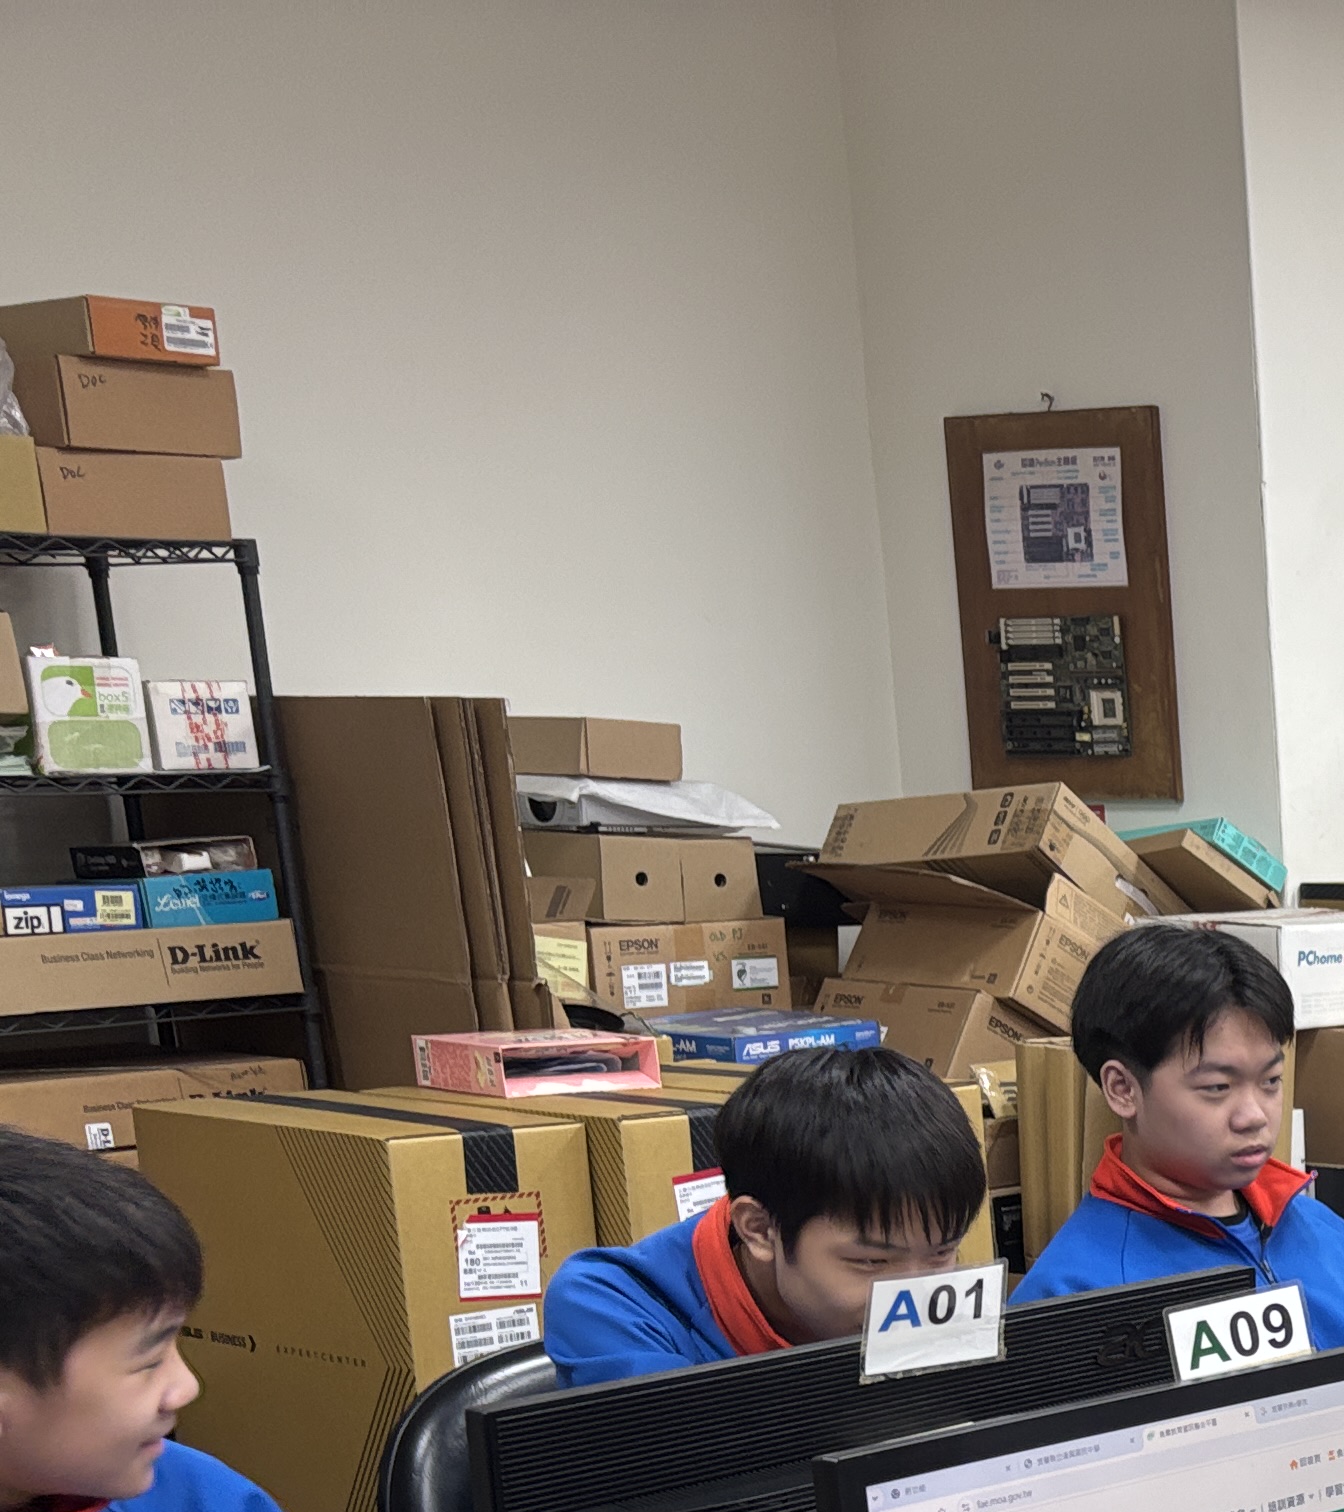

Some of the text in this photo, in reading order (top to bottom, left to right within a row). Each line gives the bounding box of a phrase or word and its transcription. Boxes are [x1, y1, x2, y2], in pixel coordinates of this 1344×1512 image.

[13, 910, 42, 934] zip
[105, 947, 155, 961] Networking
[167, 940, 262, 966] D-Link
[618, 939, 660, 952] EPSON
[1058, 933, 1091, 962] EPSON
[1297, 950, 1343, 967] PChome
[833, 991, 864, 1007] EPSON
[986, 1014, 1024, 1043] EPSON
[742, 1039, 781, 1056] ASUS
[877, 1277, 985, 1334] A01
[1188, 1302, 1294, 1372] A09
